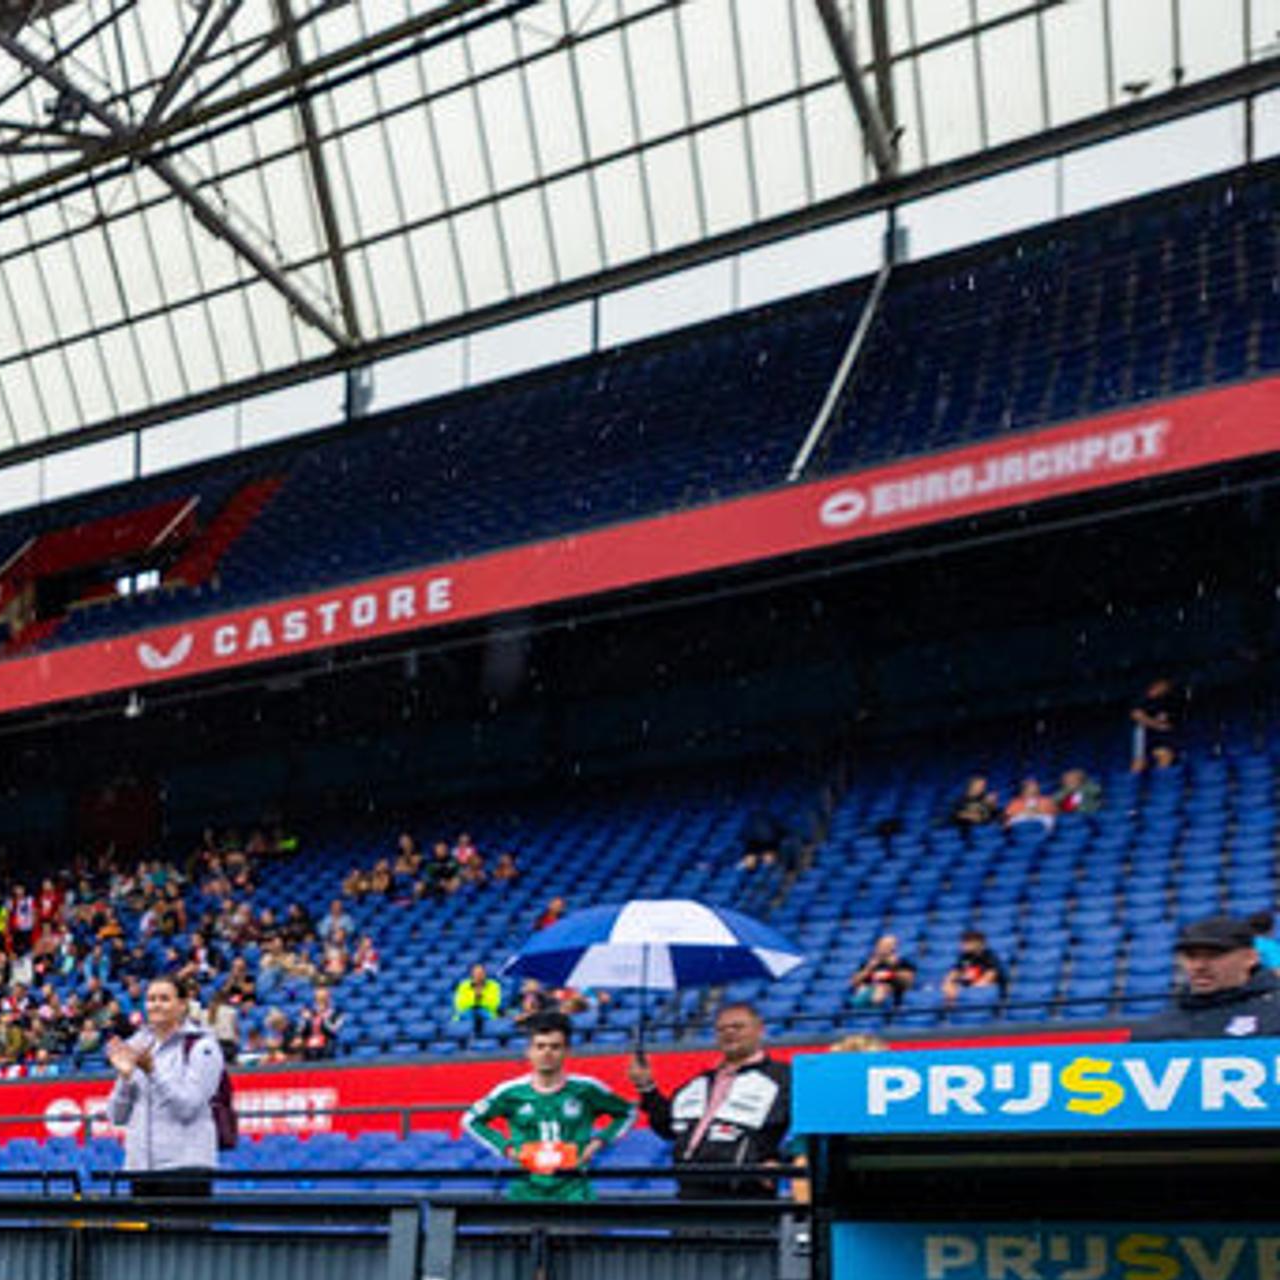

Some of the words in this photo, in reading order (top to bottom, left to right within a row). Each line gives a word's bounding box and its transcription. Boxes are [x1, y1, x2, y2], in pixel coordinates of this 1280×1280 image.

[870, 420, 1171, 518] EUROJACKPOT
[213, 577, 453, 657] CASTORE
[866, 1056, 1280, 1116] PRIJSVR
